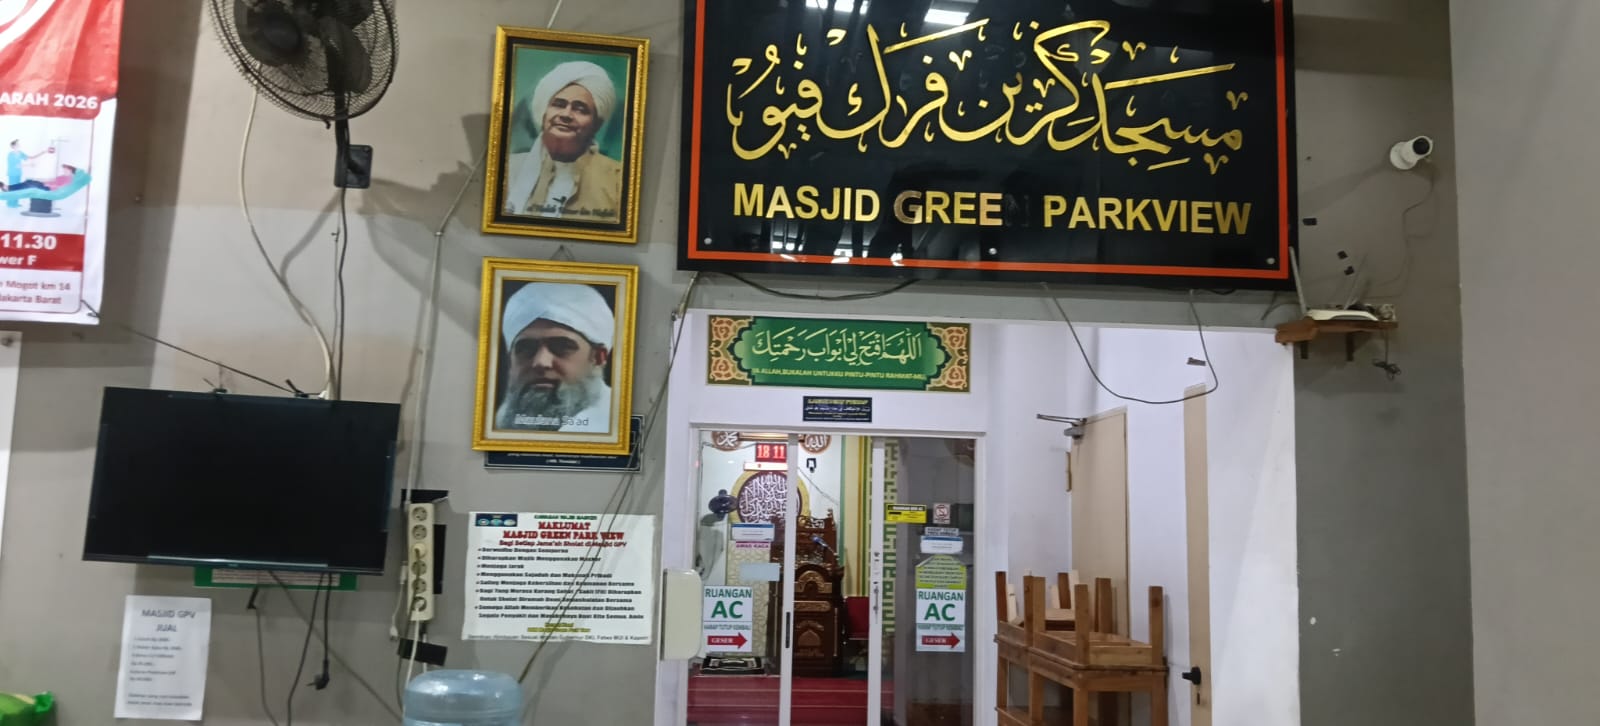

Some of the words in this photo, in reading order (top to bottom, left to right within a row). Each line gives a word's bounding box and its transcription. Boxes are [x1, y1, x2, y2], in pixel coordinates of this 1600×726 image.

[53, 94, 98, 109] 2026
[733, 183, 880, 223] MASJID
[893, 189, 1031, 228] GREE
[1043, 194, 1252, 236] PARKVIEW
[0, 232, 57, 250] 11.30
[27, 254, 38, 266] F
[6, 280, 38, 291] Mogot
[41, 281, 57, 290] km
[59, 283, 71, 291] 14
[35, 295, 62, 305] Barat
[757, 444, 770, 459] 18
[538, 521, 591, 530] MAKLUMAT
[503, 530, 538, 539] MASJID
[540, 531, 571, 540] GREEN
[573, 531, 598, 540] PARK
[600, 532, 624, 540] VIEW
[705, 588, 752, 598] RUANGAN
[918, 590, 964, 601] RUANGAN
[141, 609, 176, 618] MASJID
[176, 610, 197, 619] GPV
[711, 600, 744, 619] AC
[924, 603, 956, 621] AC
